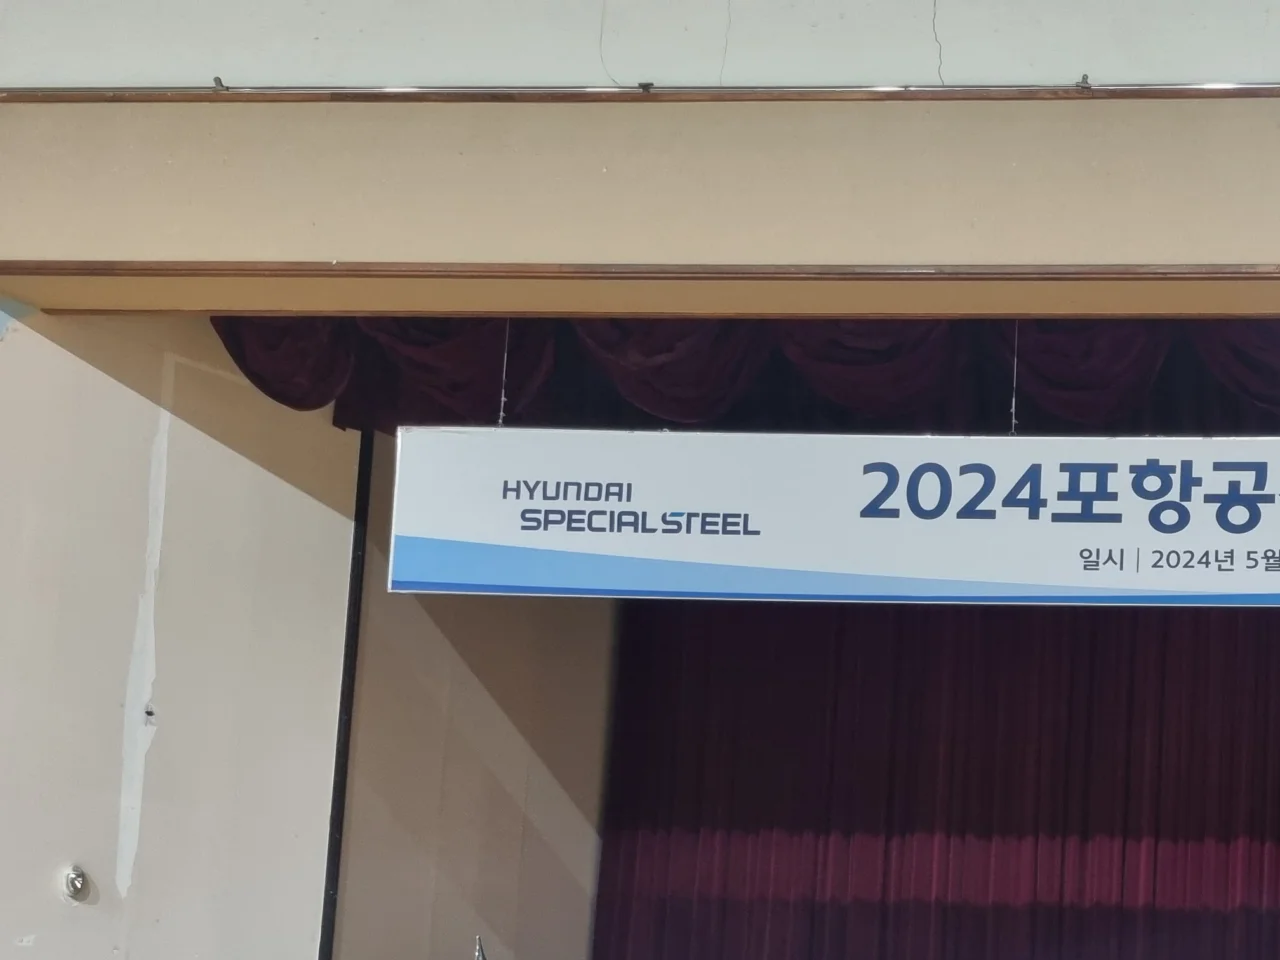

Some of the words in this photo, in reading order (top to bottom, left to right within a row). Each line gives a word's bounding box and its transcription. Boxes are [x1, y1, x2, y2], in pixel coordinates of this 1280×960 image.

[502, 479, 633, 503] HYUNDAI
[1079, 547, 1125, 572] 일시
[1150, 547, 1236, 572] 2024년
